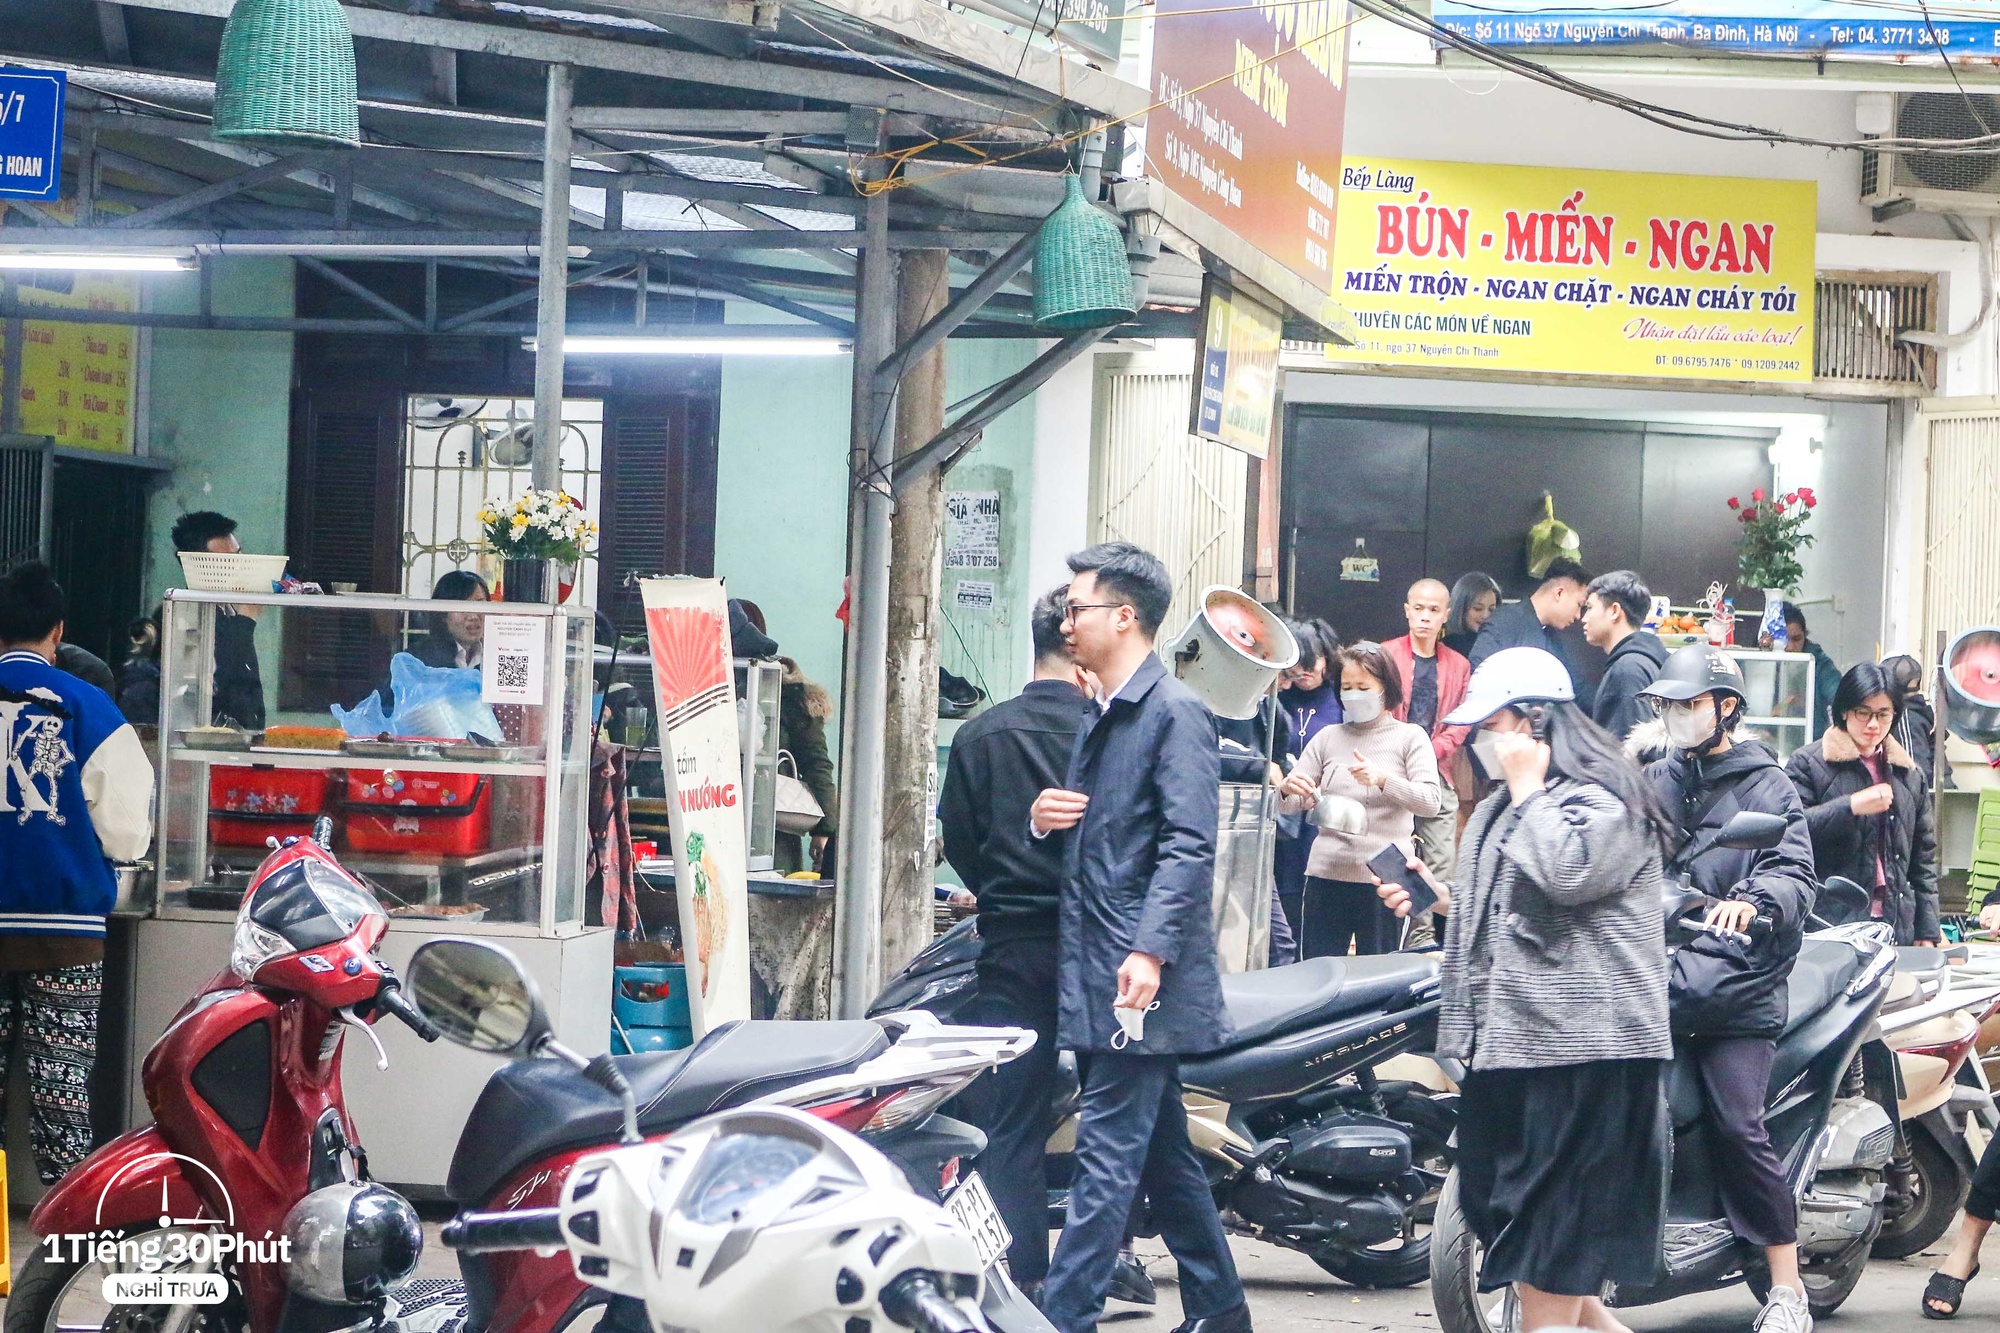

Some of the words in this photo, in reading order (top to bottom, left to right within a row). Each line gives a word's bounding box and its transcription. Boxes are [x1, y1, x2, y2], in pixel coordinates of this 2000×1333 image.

[1475, 20, 1492, 40] Số
[1495, 22, 1510, 39] 11
[1514, 21, 1541, 43] Ngõ
[1544, 22, 1559, 40] 37
[1693, 23, 1711, 41] Ba
[1714, 23, 1750, 44] Đình,
[1754, 24, 1772, 43] Hà
[1776, 24, 1798, 46] Nội
[1830, 26, 1854, 43] Tel:
[1857, 27, 1877, 44] 04.
[1882, 26, 1913, 44] 3771
[6, 155, 42, 177] HOAN
[1343, 166, 1371, 190] Bếp
[1376, 170, 1414, 193] Làng
[1376, 191, 1469, 258] BÚN
[1505, 191, 1614, 266] MIẾN
[1649, 219, 1774, 273] NGAN
[1344, 263, 1403, 292] MIẾN
[1409, 270, 1467, 301] TRỘN
[1485, 279, 1548, 300] NGAN
[1554, 277, 1612, 309] CHẶT
[1629, 286, 1691, 308] NGAN
[1697, 285, 1755, 311] CHÁY
[1760, 285, 1796, 312] TỎI
[1353, 310, 1400, 329] HUYÊN
[1405, 312, 1432, 331] CÁC
[1436, 313, 1467, 333] MÓN
[1471, 313, 1490, 334] VỀ
[1493, 319, 1531, 336] NGAN
[1623, 318, 1674, 342] Nhận
[1677, 324, 1706, 345] đặt
[1733, 328, 1759, 343] các
[1761, 326, 1804, 346] loại!
[1405, 343, 1417, 354] 37
[1473, 347, 1499, 358] Thanh
[1655, 355, 1669, 366] ĐT:
[1672, 356, 1731, 368] 09.6795.7476
[1741, 358, 1800, 371] 09.1209.2442
[1353, 563, 1370, 572] WC
[677, 746, 697, 775] tấm
